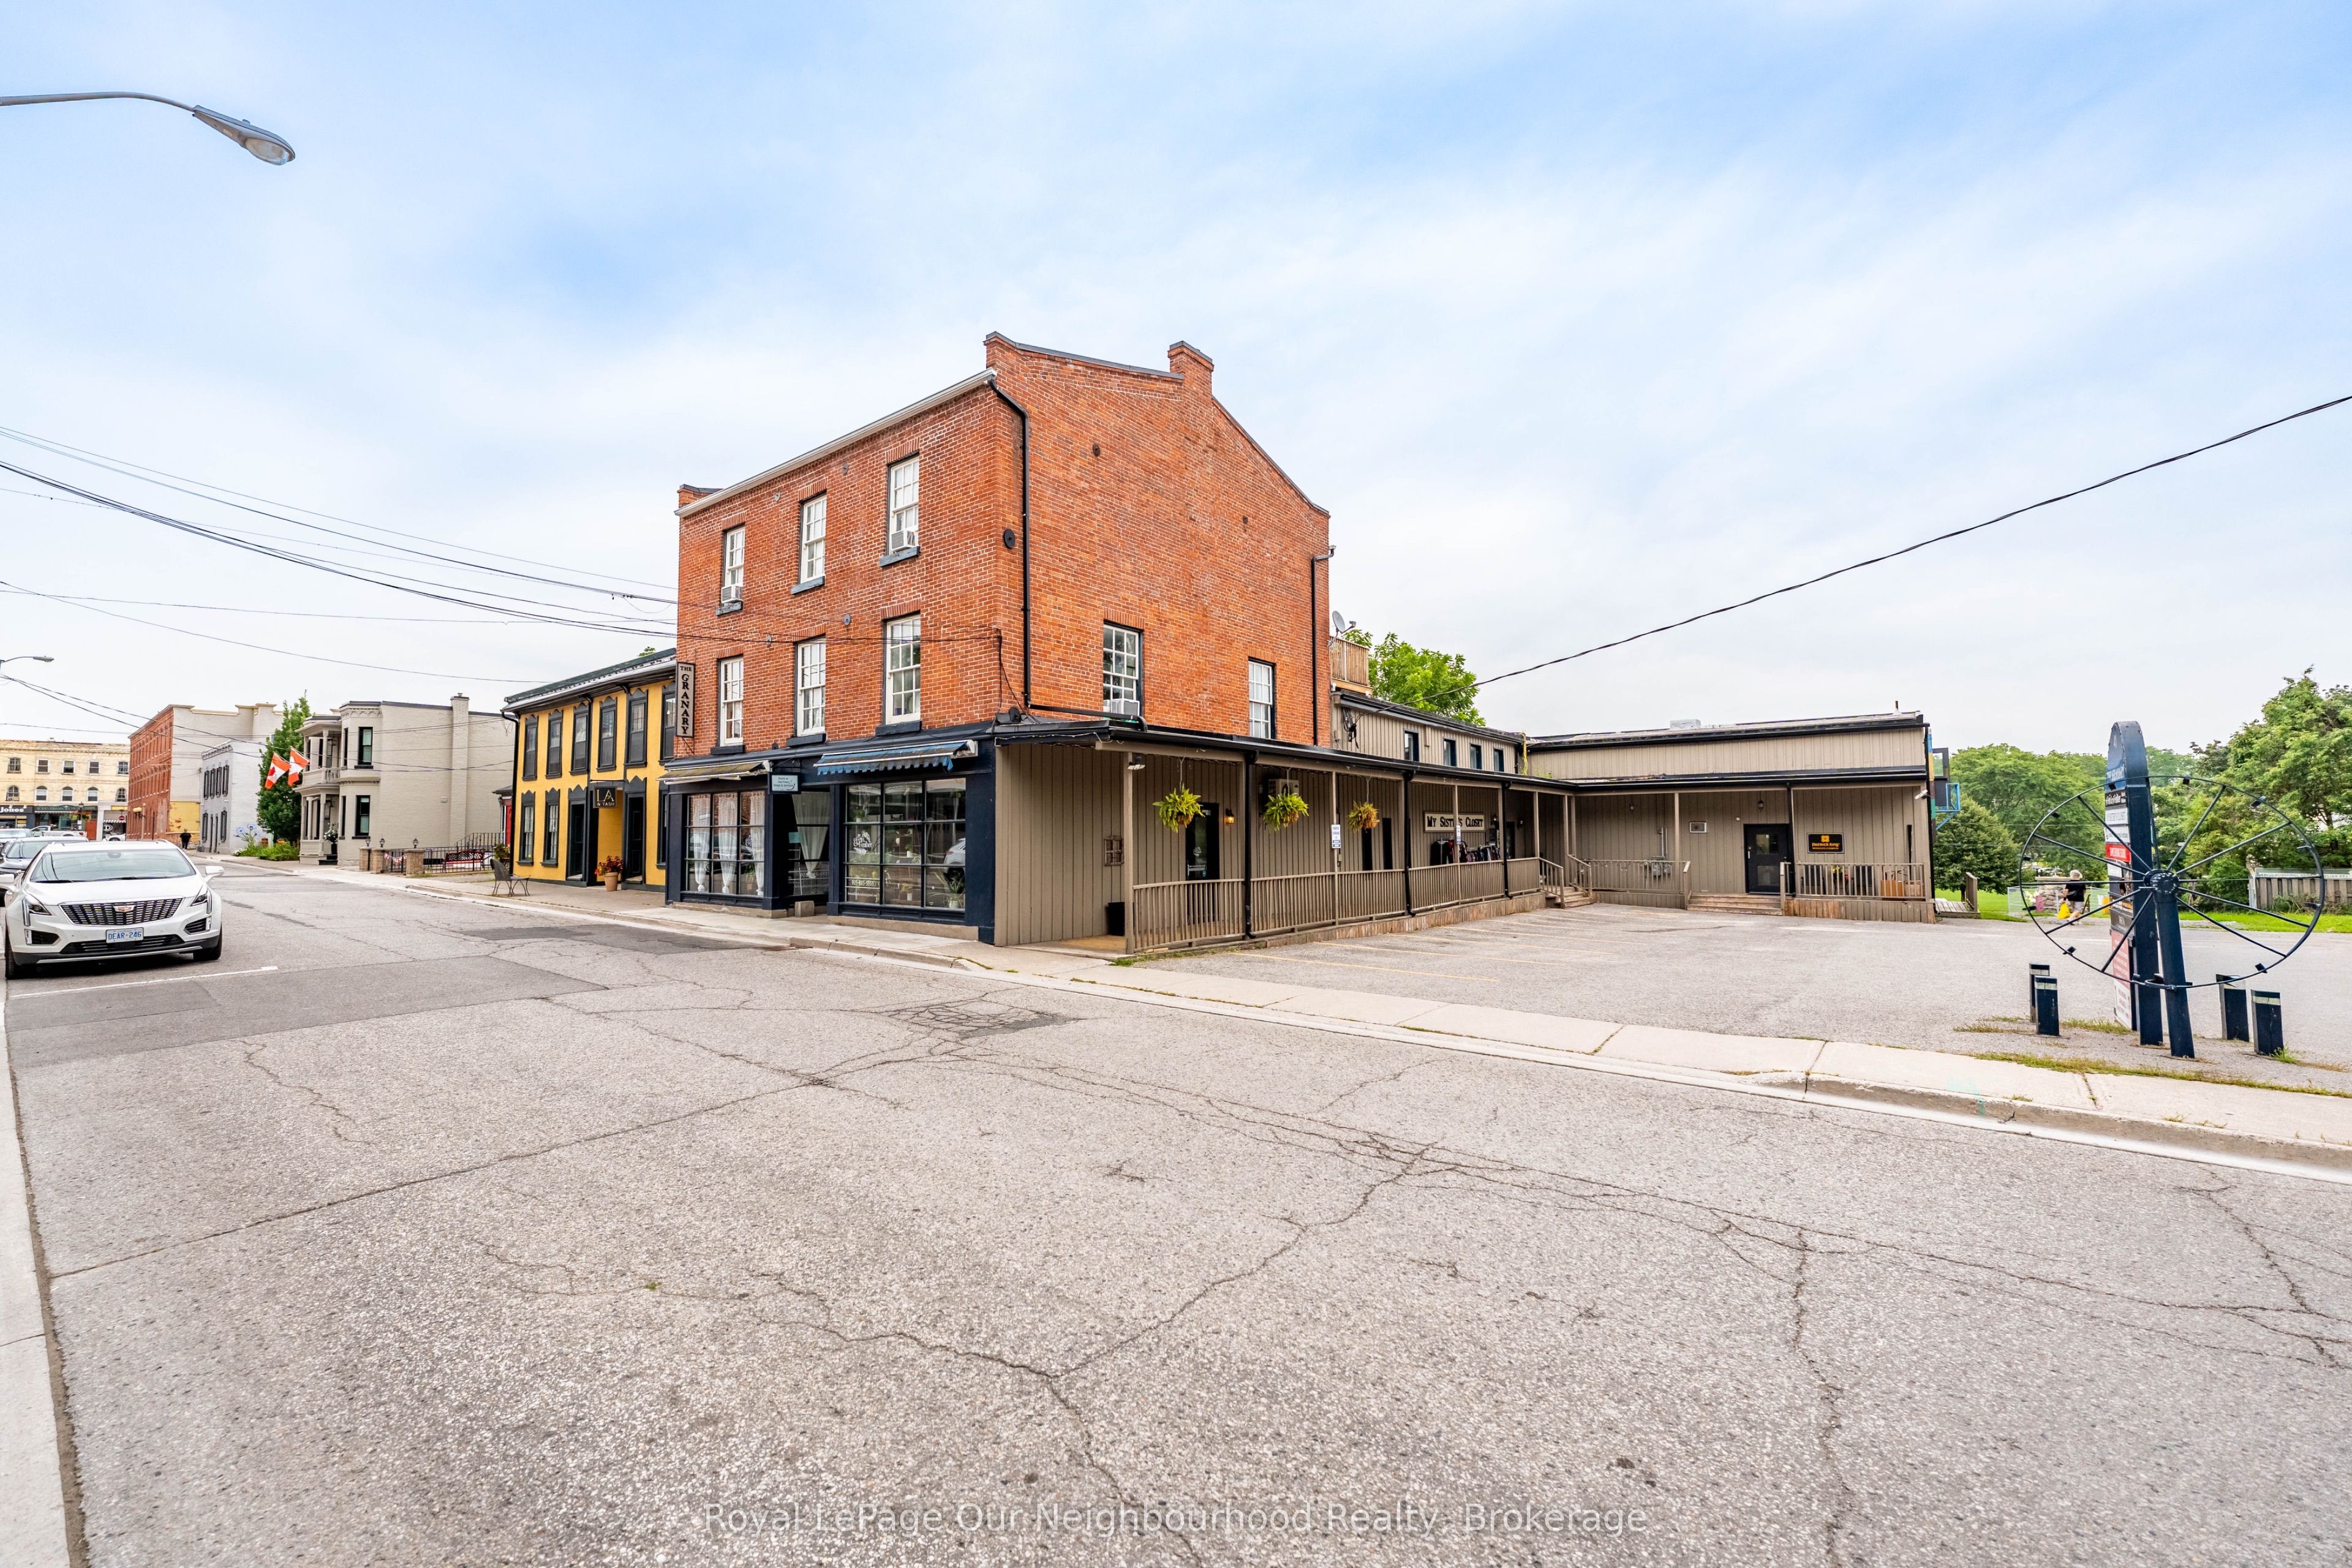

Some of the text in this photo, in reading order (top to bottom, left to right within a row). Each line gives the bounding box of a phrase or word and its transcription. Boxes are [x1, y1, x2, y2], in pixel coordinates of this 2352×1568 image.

[680, 674, 689, 734] GRANARY
[1427, 816, 1483, 827] MY SIST'S CLOSET
